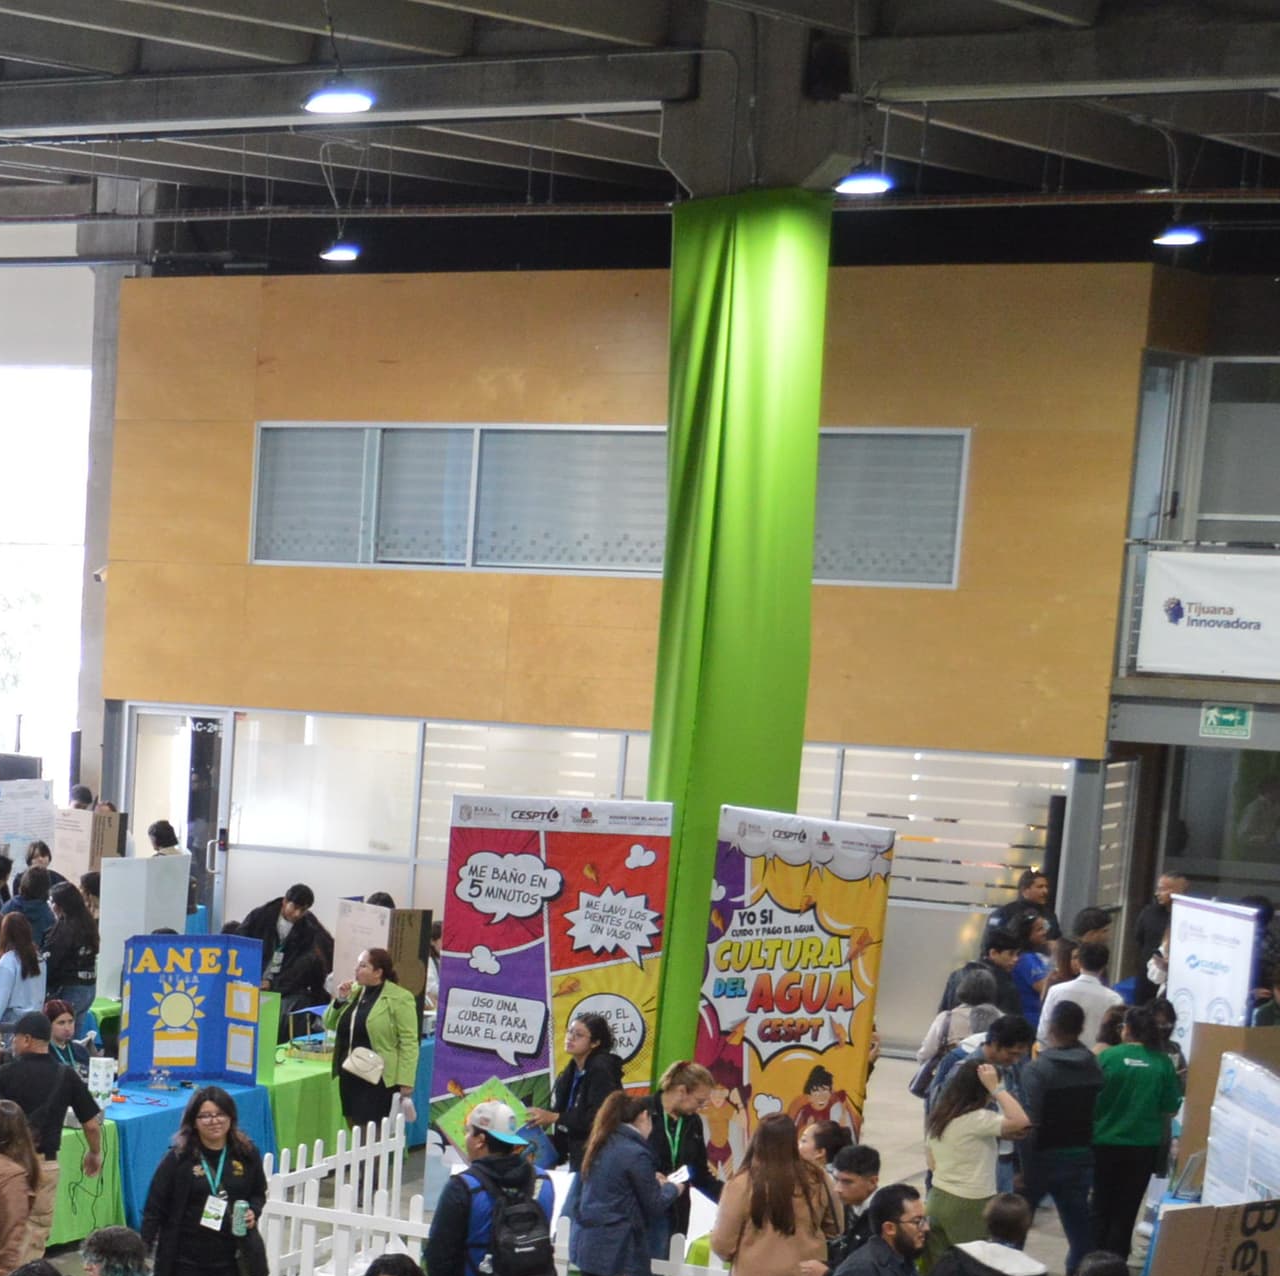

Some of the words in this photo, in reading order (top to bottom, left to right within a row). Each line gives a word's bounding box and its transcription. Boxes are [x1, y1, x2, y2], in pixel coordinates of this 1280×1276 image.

[1186, 602, 1234, 616] Tijuana
[1186, 616, 1261, 630] Innovadora
[511, 810, 545, 820] CESPT
[772, 829, 799, 841] CESPT
[468, 865, 487, 878] ME
[491, 864, 527, 885] BAÑO
[530, 874, 548, 889] EN
[468, 879, 483, 898] 5
[485, 889, 539, 906] MINUTOS
[586, 900, 601, 911] ME
[602, 903, 626, 916] LAVO
[628, 910, 648, 922] LOS
[738, 910, 756, 926] YO
[760, 909, 773, 925] SI
[584, 912, 622, 927] DIENTES
[625, 920, 643, 933] CON
[731, 927, 753, 937] CUIDO
[756, 927, 761, 936] Y
[762, 926, 782, 936] PAGO
[784, 926, 792, 934] EL
[794, 924, 815, 934] AGUA
[590, 925, 604, 936] UN
[606, 928, 631, 941] VASO
[714, 937, 843, 972] CULTURA
[713, 977, 748, 999] DEL
[746, 971, 855, 1014] AGUA
[472, 996, 494, 1008] USO
[496, 999, 518, 1013] UNA
[458, 1009, 497, 1025] CUBETA
[501, 1016, 528, 1030] PARA
[616, 1008, 629, 1019] EL
[447, 1024, 481, 1038] LAVAR
[484, 1029, 497, 1040] EL
[500, 1032, 535, 1046] CARRO
[623, 1022, 637, 1033] LA
[757, 1017, 824, 1043] CESPT
